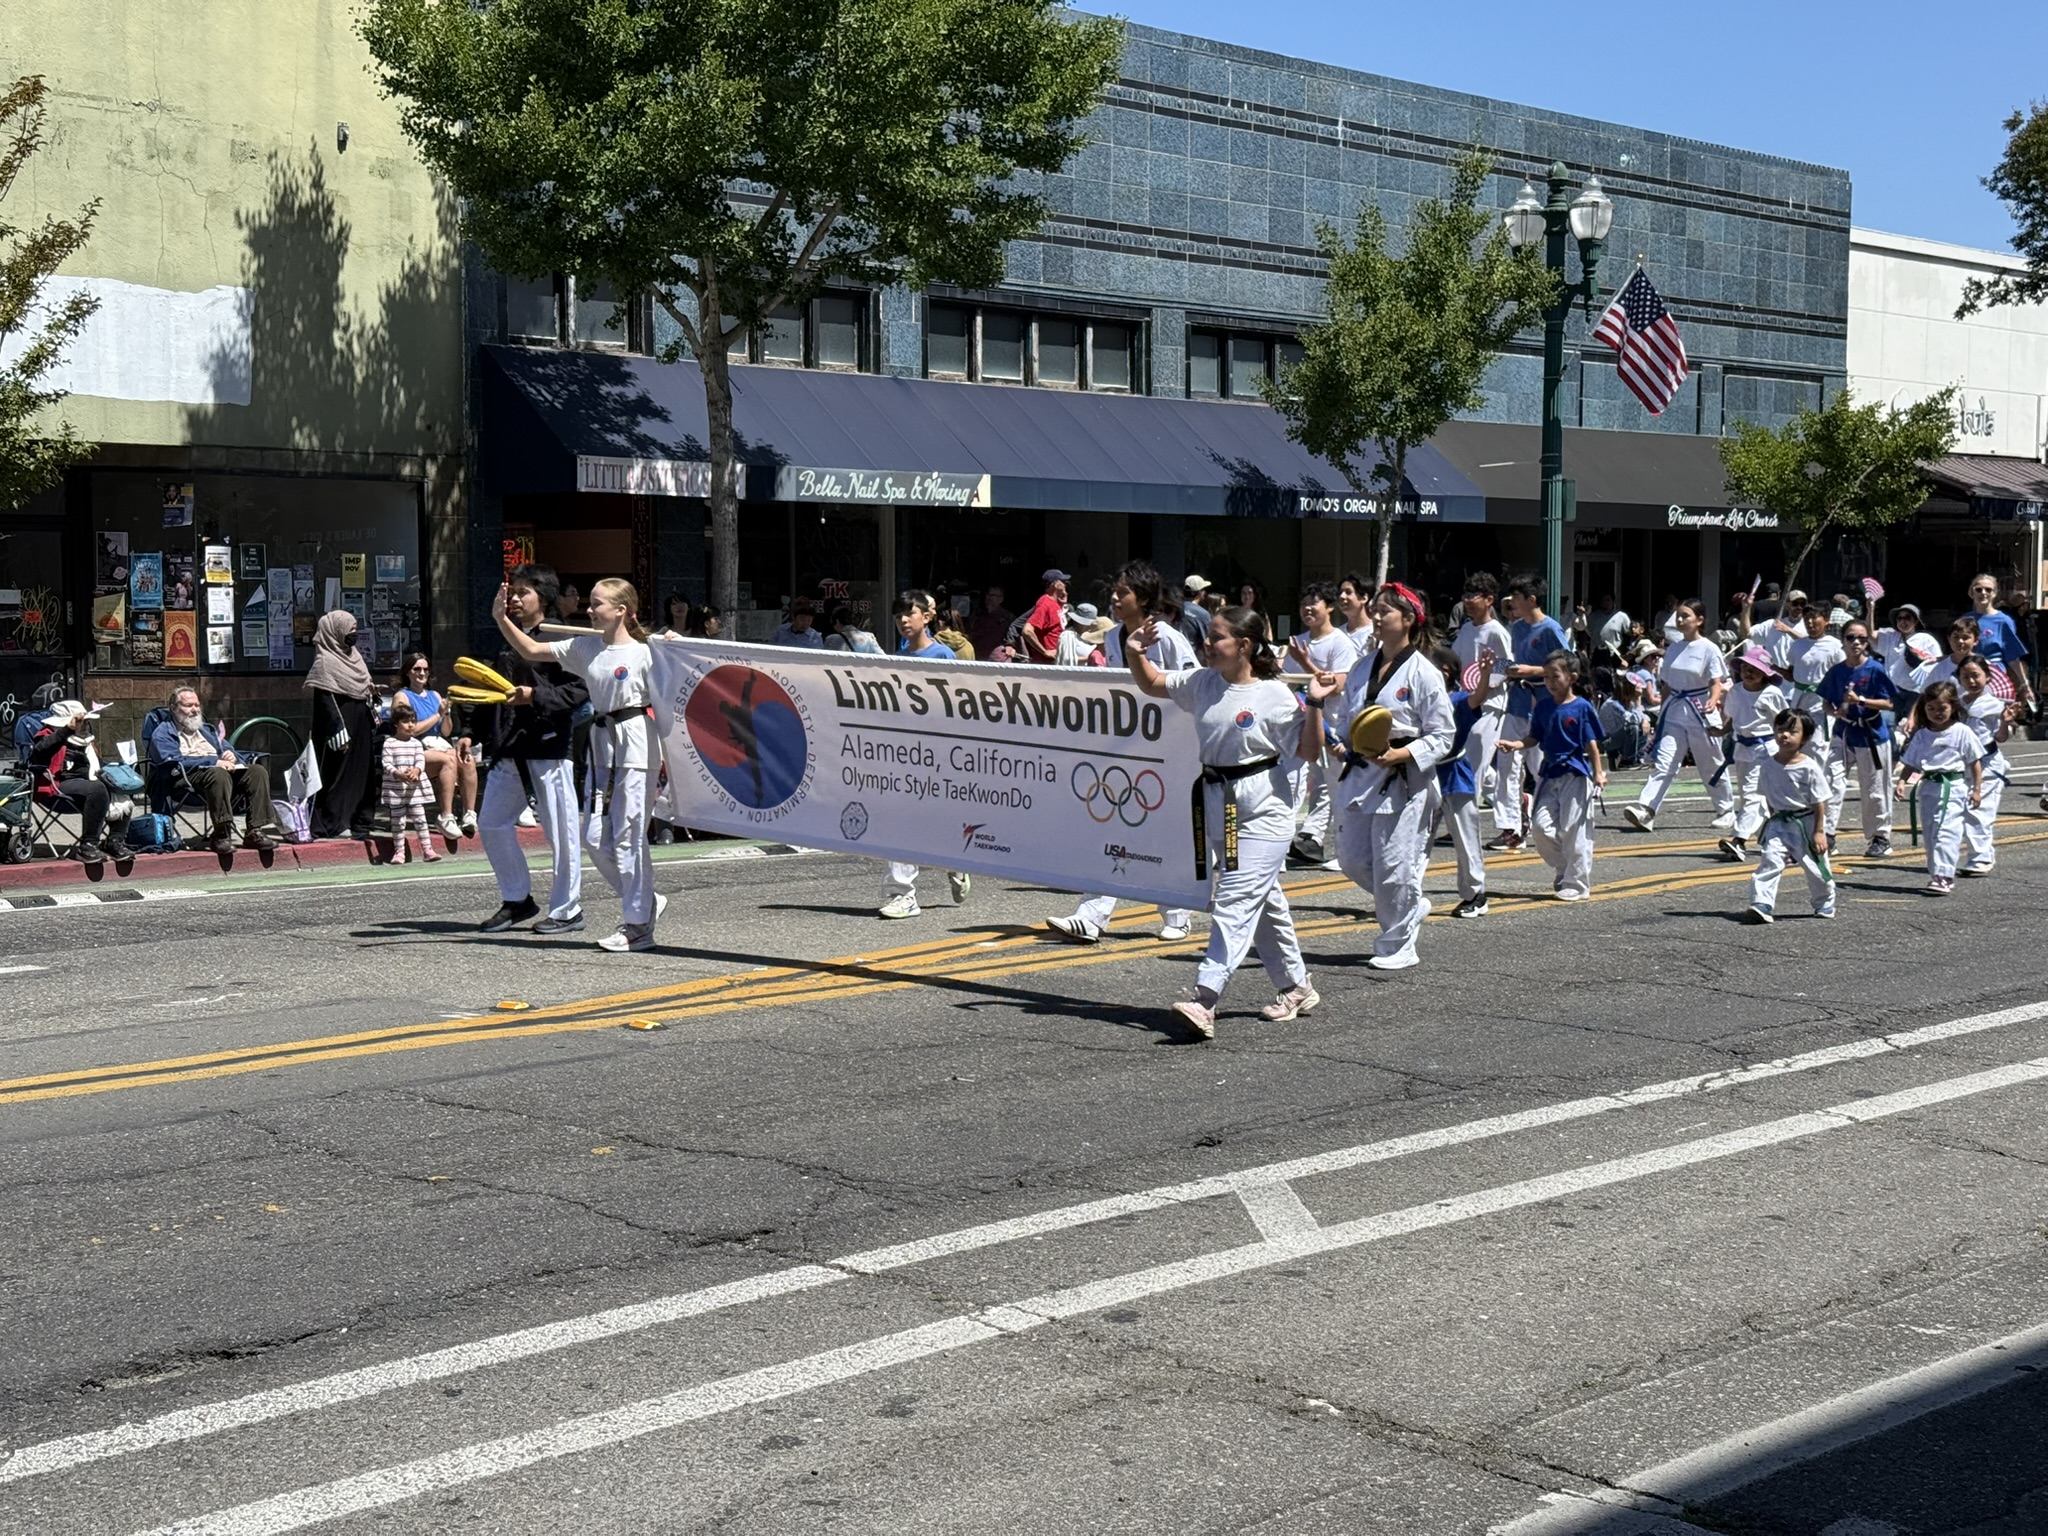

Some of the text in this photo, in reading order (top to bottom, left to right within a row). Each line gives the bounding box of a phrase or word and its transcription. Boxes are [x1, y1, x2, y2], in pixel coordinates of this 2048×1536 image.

[584, 462, 635, 491] LITTLE
[799, 470, 842, 498] Bella
[843, 472, 880, 499] Nail
[881, 477, 907, 503] Spa
[910, 476, 923, 500] &
[1300, 497, 1438, 515] TOMO'S ORGA NAIL SPA
[1667, 504, 1779, 531] Triumphant Life Church
[345, 557, 361, 565] IMP
[821, 580, 850, 599] TK
[675, 663, 705, 724] RESPECT
[770, 669, 815, 733] MODESTY
[824, 669, 1162, 742] Lim's TaeKwonDo
[841, 734, 1056, 783] Alameda, California
[683, 742, 737, 813] DISCIPLINE
[747, 752, 817, 824] DETERMINATION
[842, 766, 1032, 810] Olympic Style TaeKwonDo
[974, 832, 996, 843] WORLD
[974, 841, 1011, 854] TAEKWONDO
[1104, 843, 1126, 858] USA
